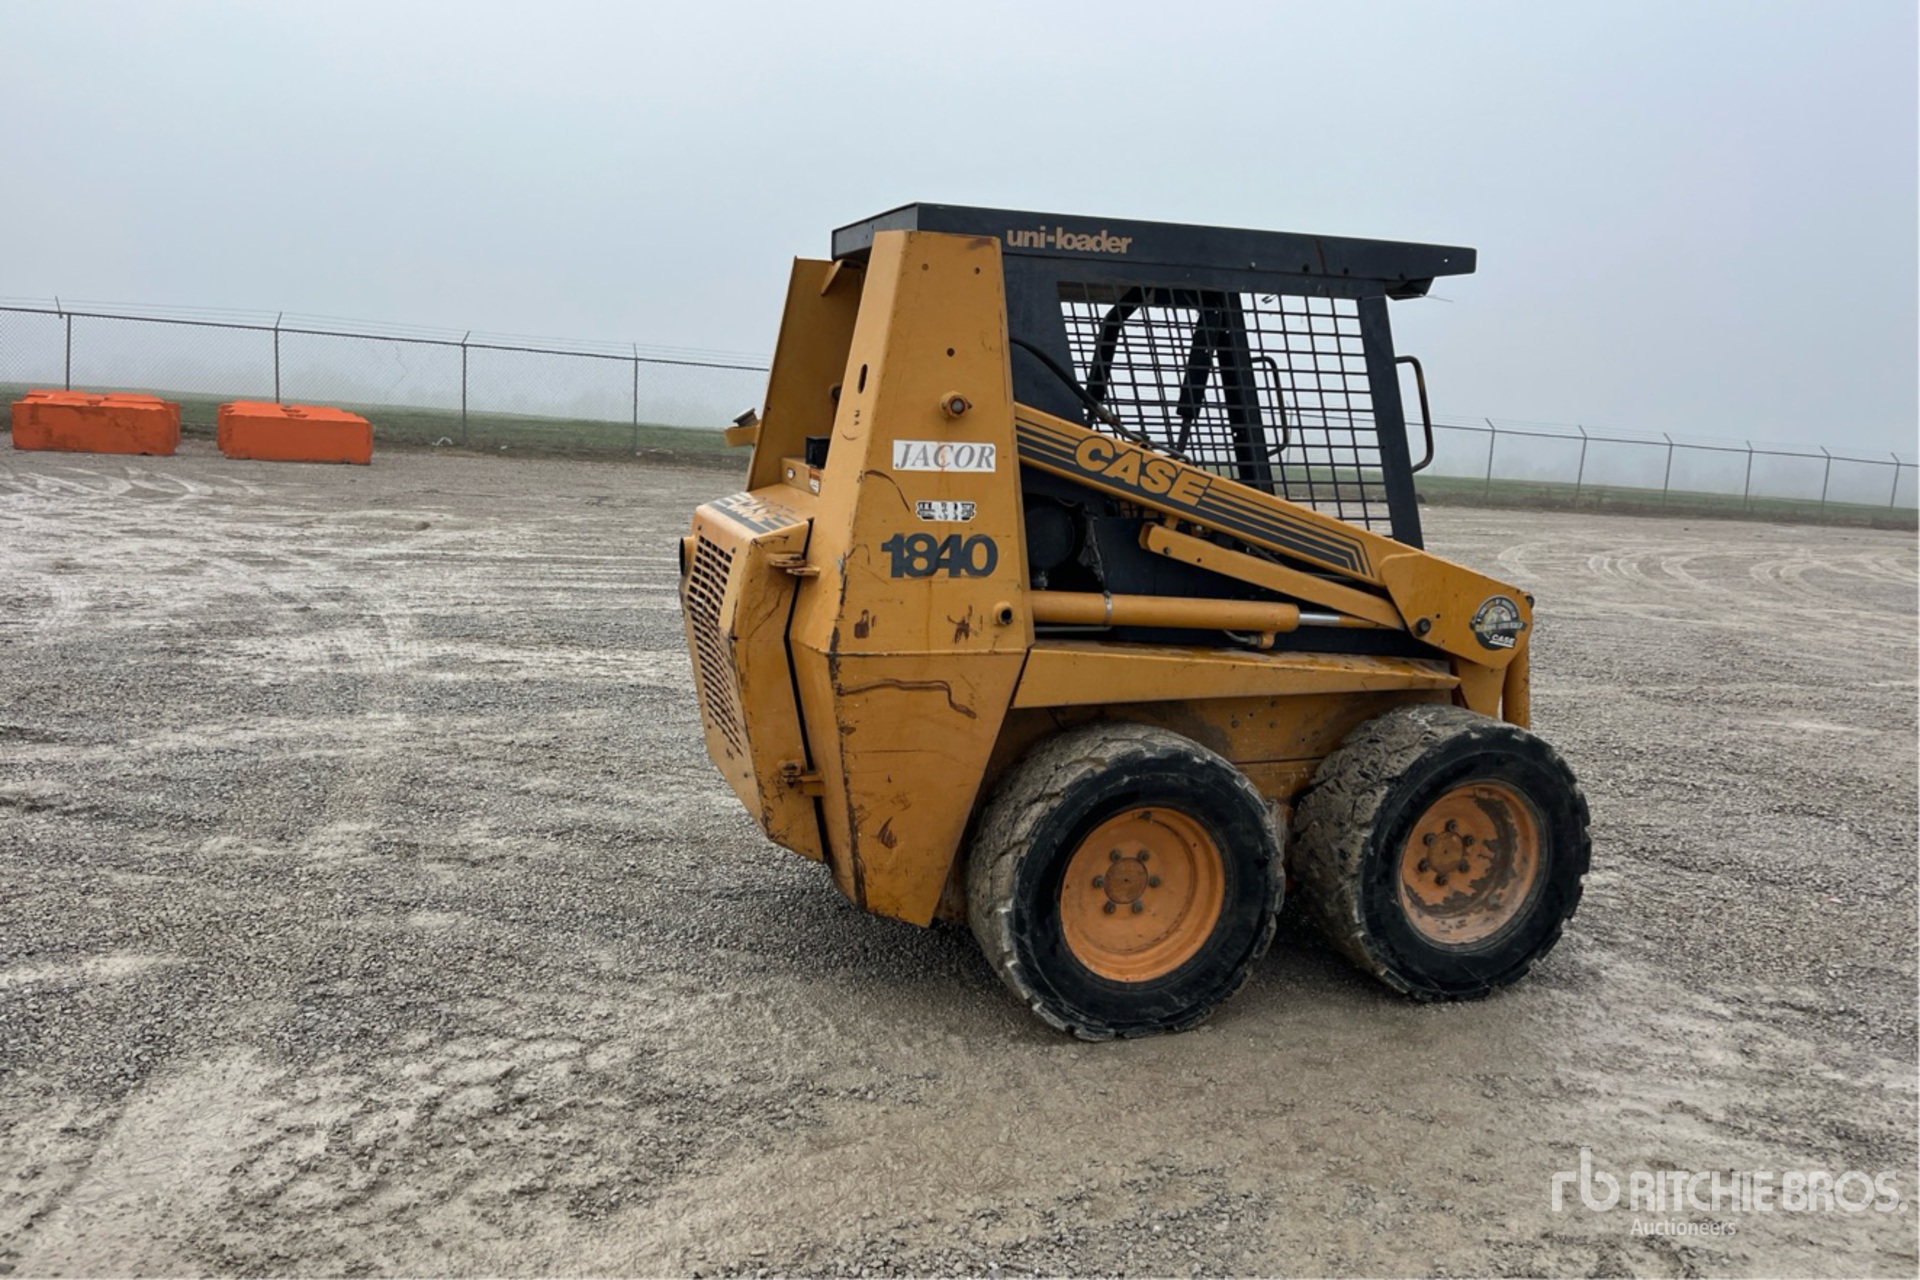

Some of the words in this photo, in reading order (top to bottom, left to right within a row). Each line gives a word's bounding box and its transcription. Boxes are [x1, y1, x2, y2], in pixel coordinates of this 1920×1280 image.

[1006, 225, 1133, 254] uni-loader
[895, 442, 995, 469] JACOR
[1075, 436, 1213, 507] CASE
[881, 532, 998, 579] 1840
